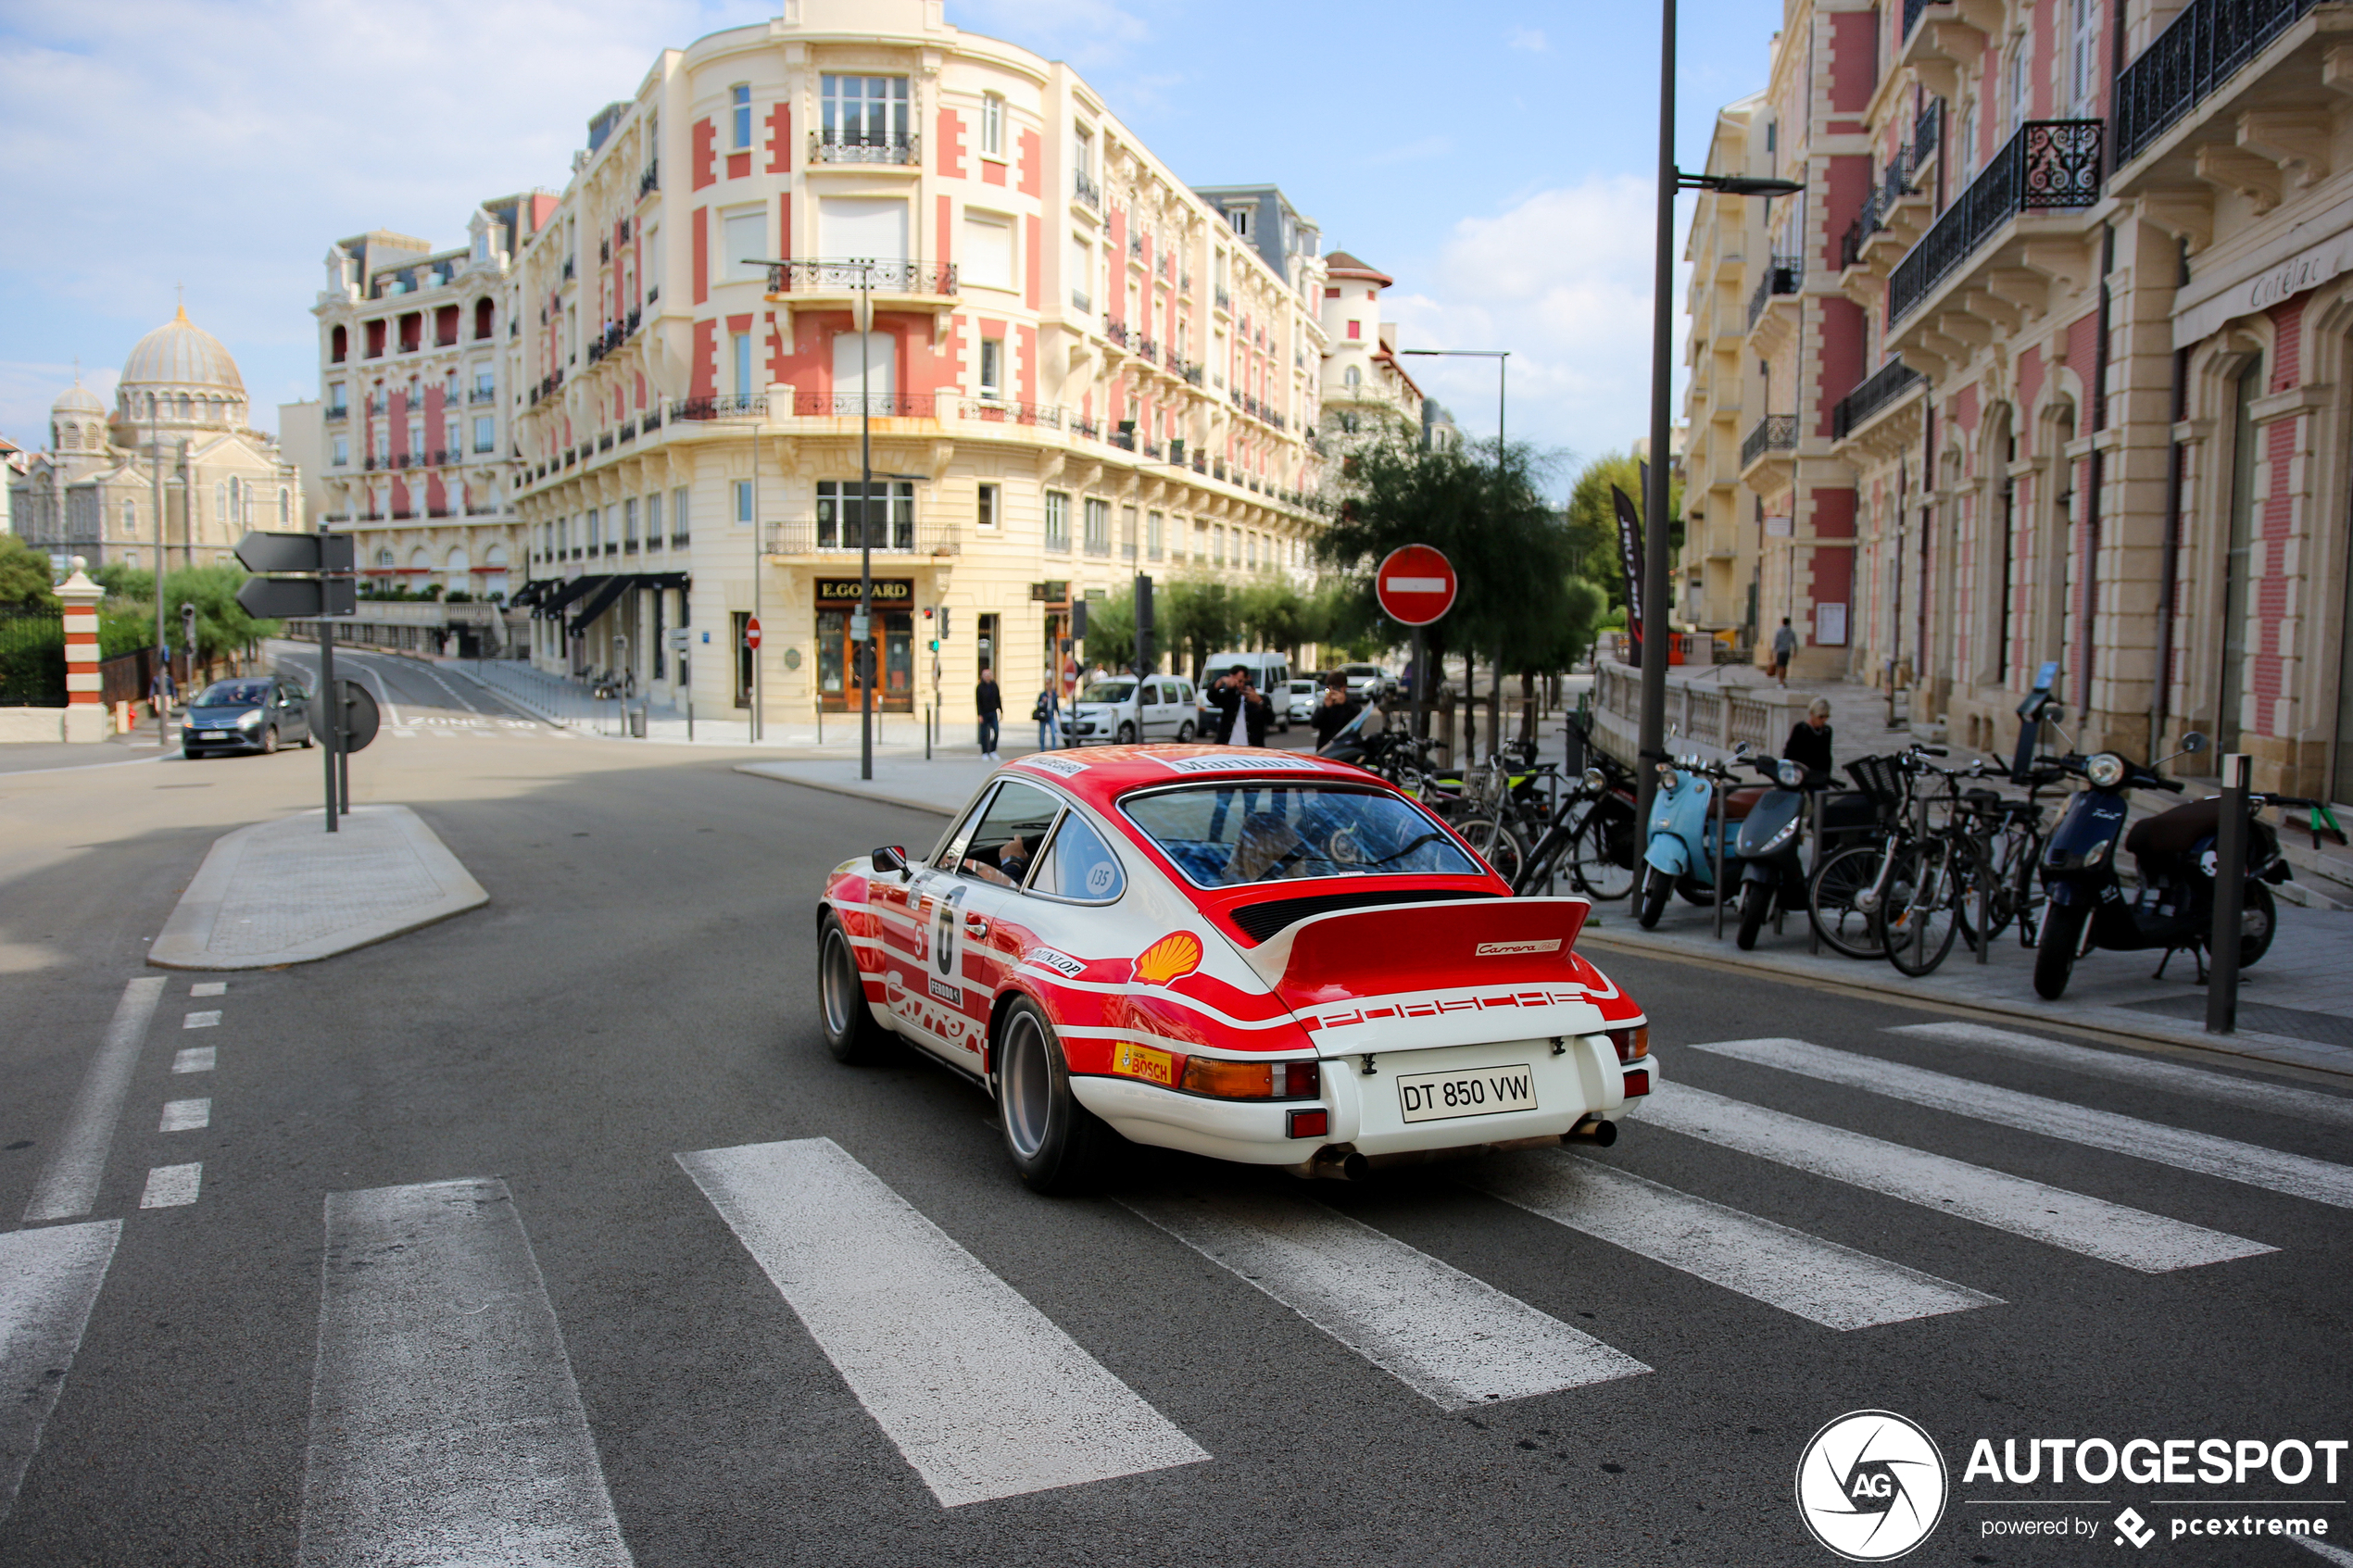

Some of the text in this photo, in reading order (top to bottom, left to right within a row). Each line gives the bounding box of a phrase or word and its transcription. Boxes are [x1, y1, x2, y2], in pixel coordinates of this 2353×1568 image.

[2251, 257, 2320, 307] Cotélac
[822, 583, 908, 598] E.GOARD
[406, 716, 537, 730] ZONE 30
[1174, 759, 1315, 771] Marlboro
[1090, 869, 1110, 886] 135
[1478, 941, 1559, 954] Carrera RS
[1028, 949, 1082, 973] DUNLOP
[931, 980, 954, 1000] FERODO
[1319, 990, 1587, 1031] PORSCHE
[1131, 1057, 1167, 1082] BOSCH
[1403, 1074, 1528, 1111] DT 850 VW
